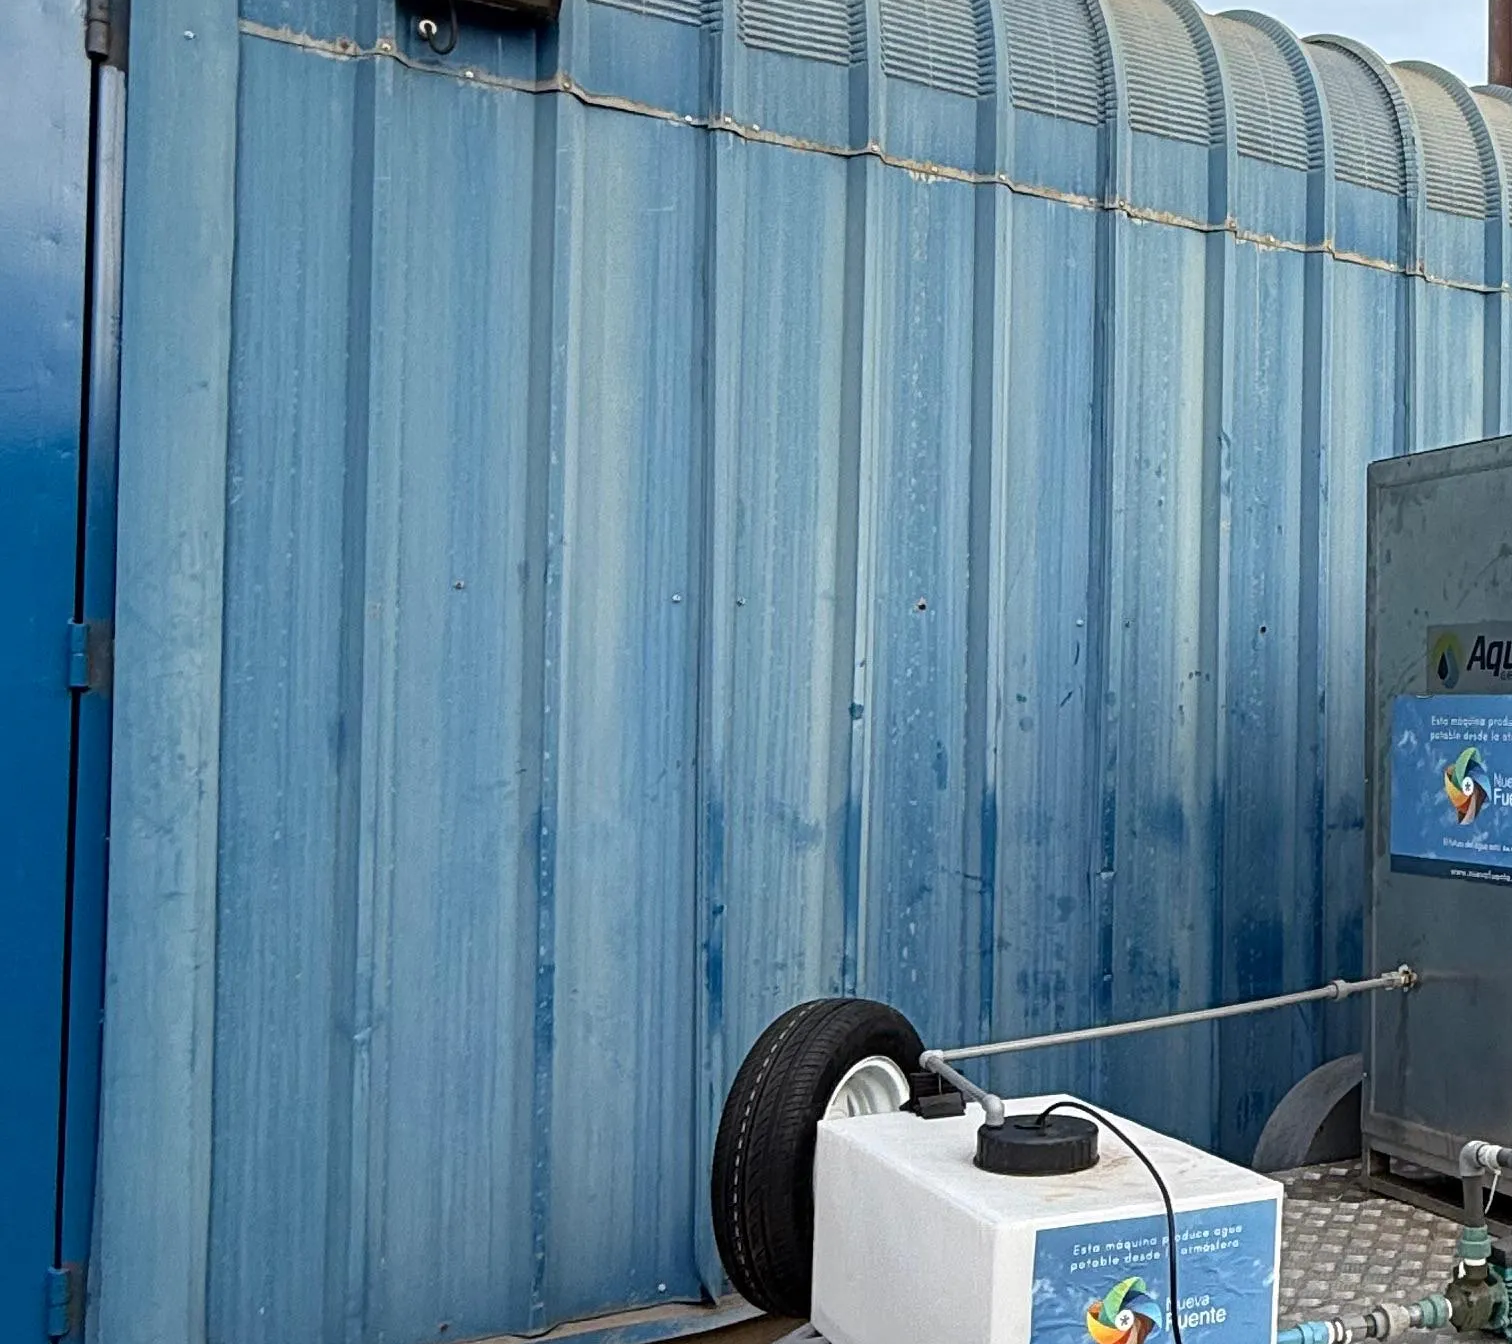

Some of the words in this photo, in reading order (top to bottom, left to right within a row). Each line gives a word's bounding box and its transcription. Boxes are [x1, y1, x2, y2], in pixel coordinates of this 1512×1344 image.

[1431, 715, 1449, 726] Esta
[1073, 1244, 1101, 1256] Esta
[1105, 1237, 1157, 1254] máquina
[1162, 1229, 1210, 1246] poduce
[1214, 1225, 1243, 1239] agua
[1070, 1256, 1120, 1274] potable
[1124, 1250, 1160, 1264] desde
